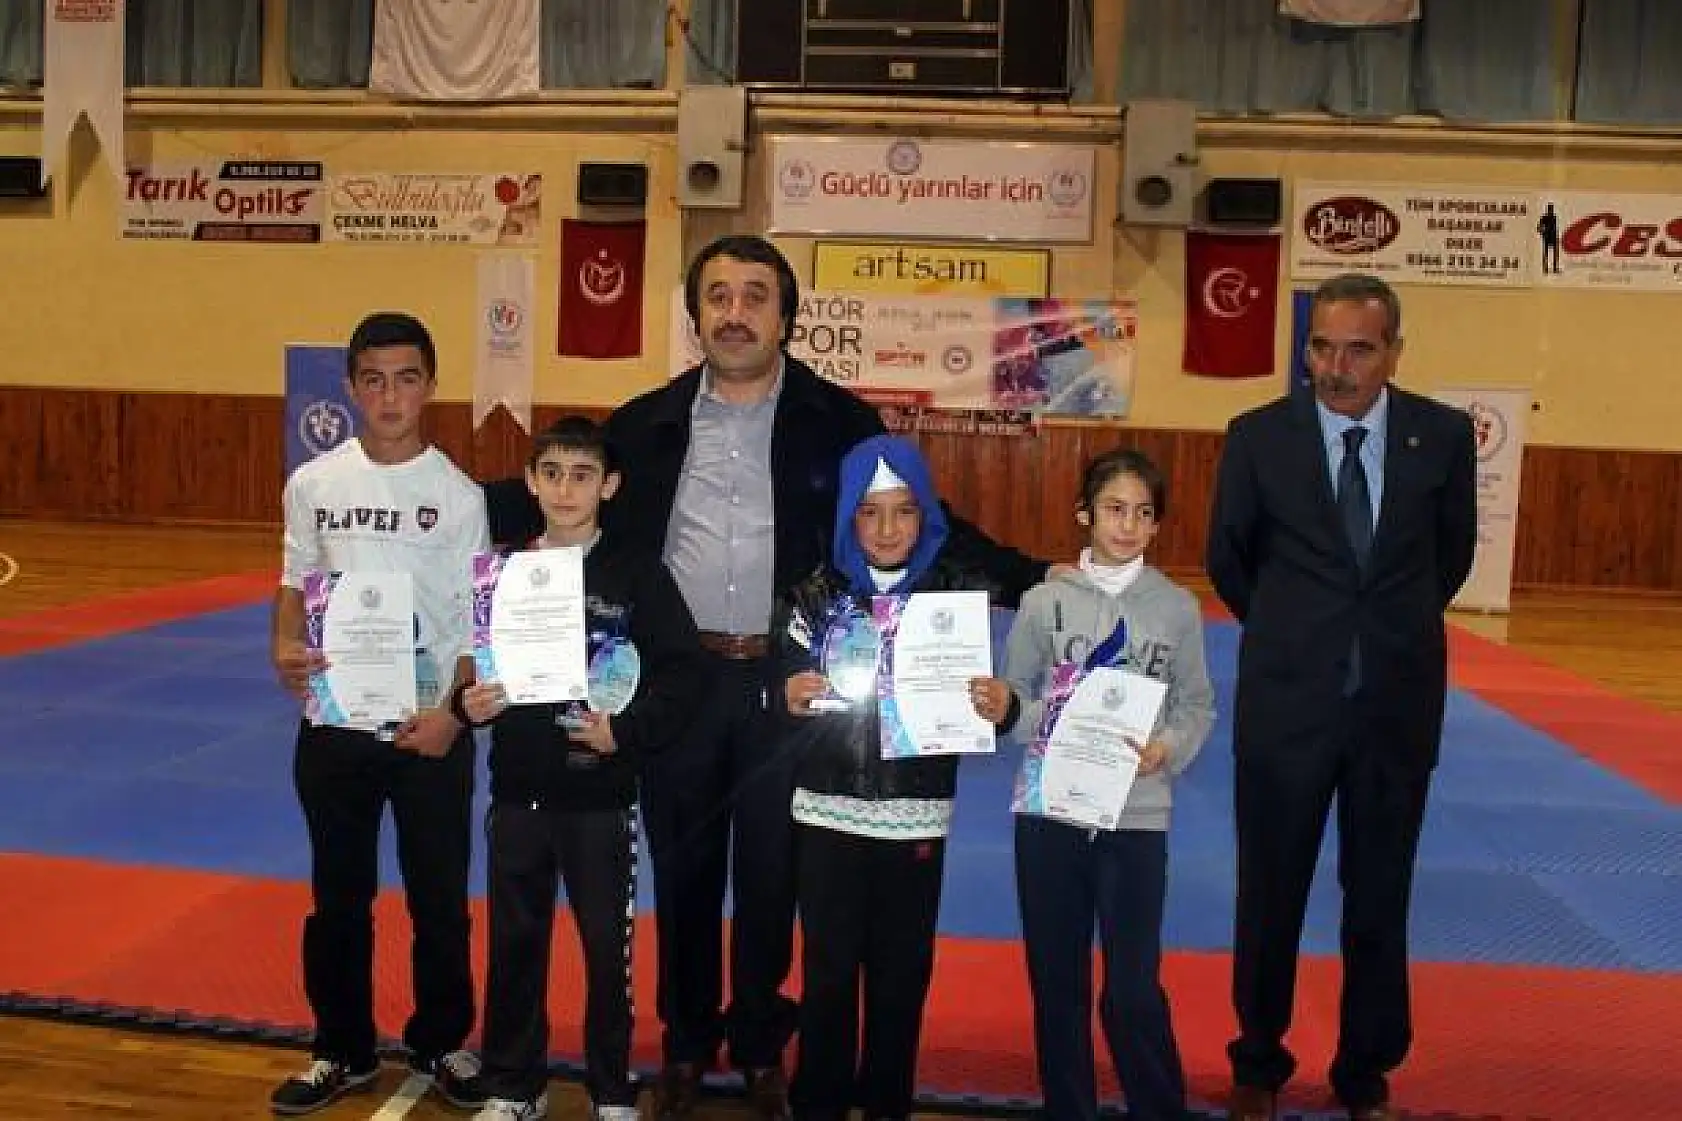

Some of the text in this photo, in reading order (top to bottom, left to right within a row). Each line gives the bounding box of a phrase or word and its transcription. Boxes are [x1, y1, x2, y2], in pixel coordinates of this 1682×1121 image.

[821, 172, 1043, 205] Güçlü yarınlar için
[853, 250, 987, 282] artsam
[798, 294, 865, 321] ATÖR
[792, 325, 863, 354] POR
[809, 360, 861, 381] TASI
